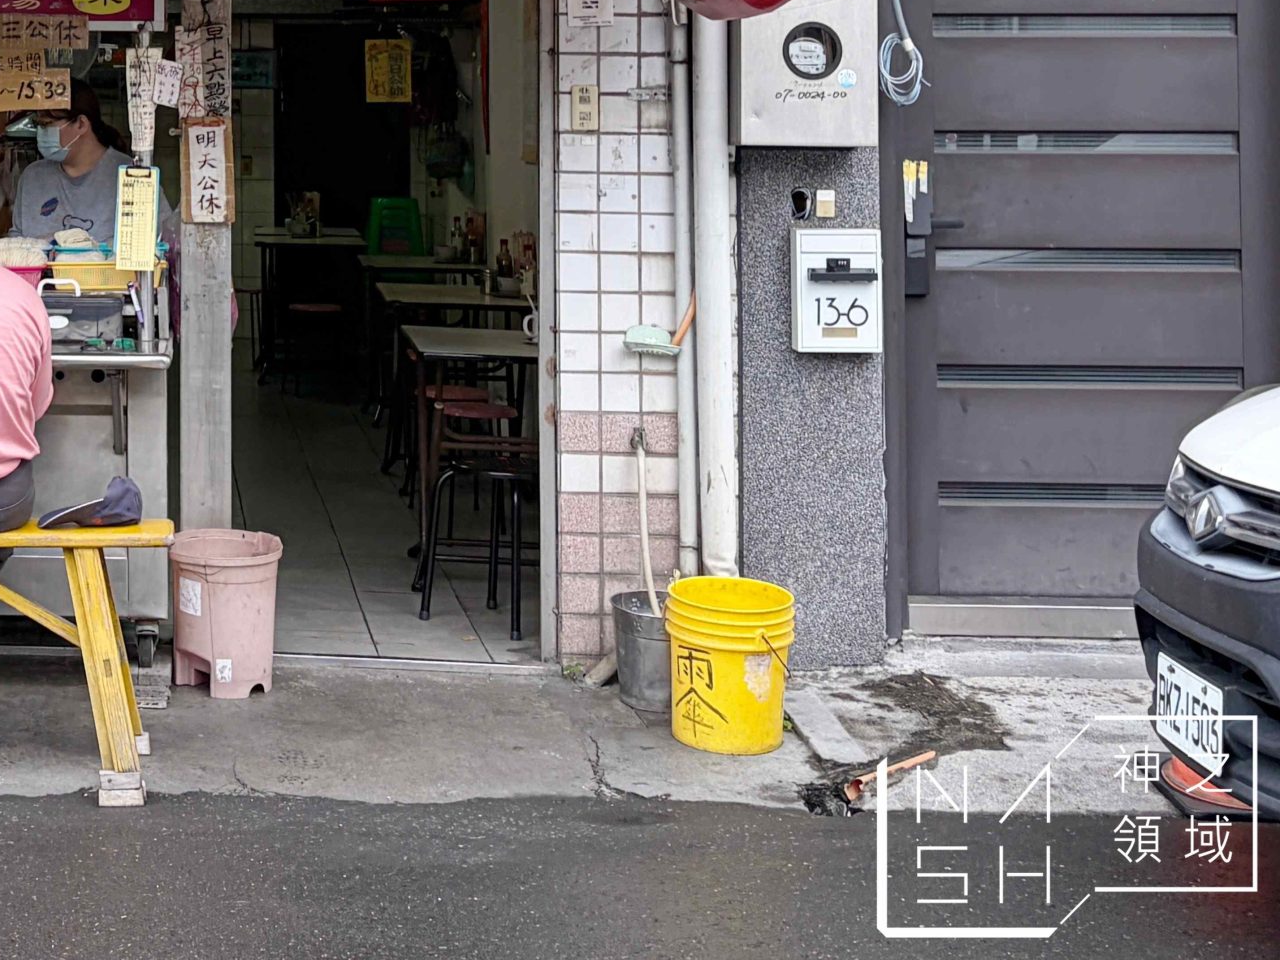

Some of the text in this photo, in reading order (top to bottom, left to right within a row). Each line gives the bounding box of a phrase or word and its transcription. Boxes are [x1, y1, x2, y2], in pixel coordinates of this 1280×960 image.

[195, 130, 222, 214] 明天公休
[815, 297, 869, 327] 13-6
